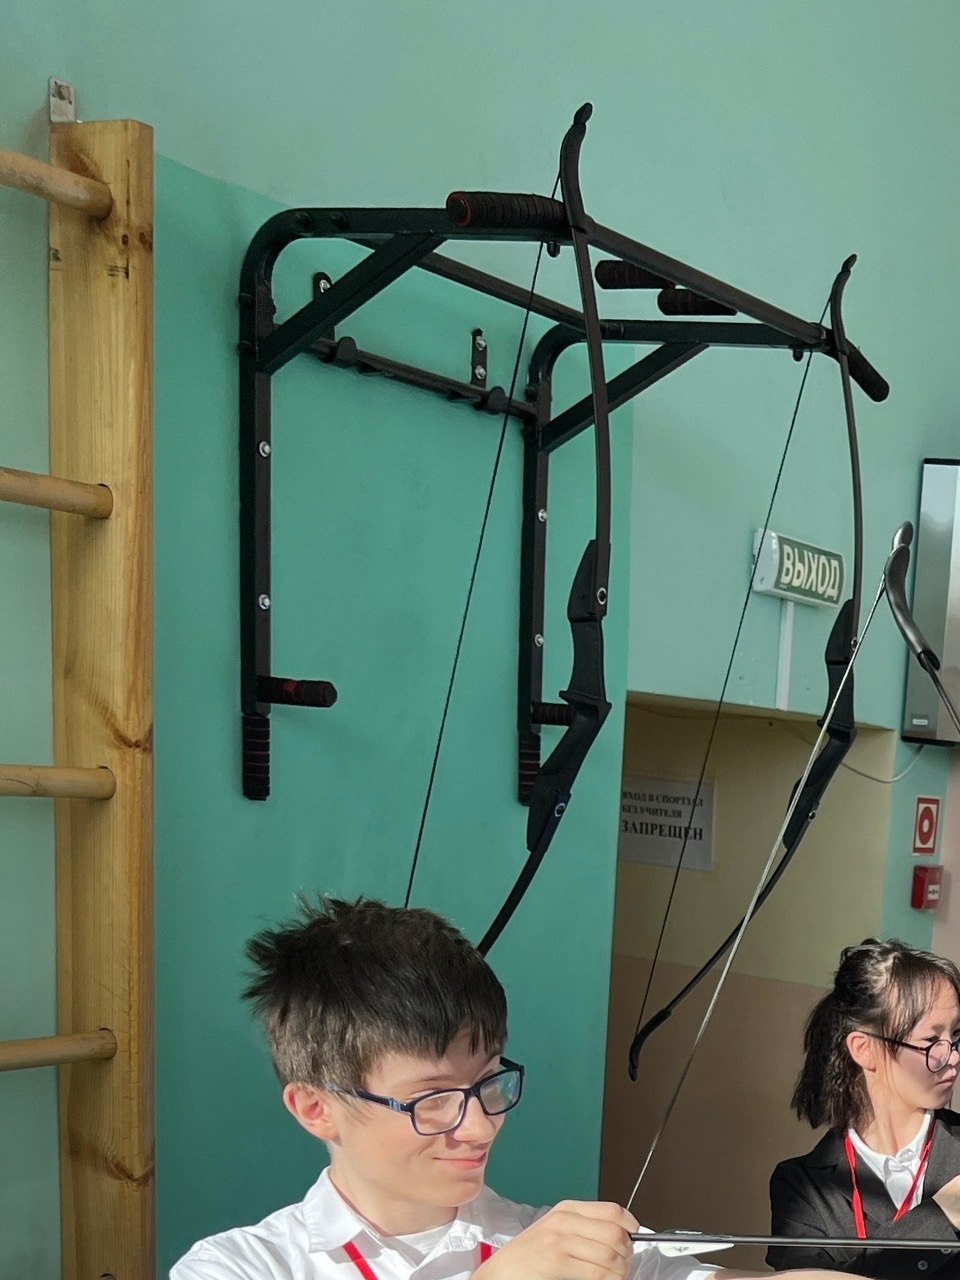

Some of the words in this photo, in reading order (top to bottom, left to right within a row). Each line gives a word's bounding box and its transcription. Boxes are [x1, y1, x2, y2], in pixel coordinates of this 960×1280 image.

[780, 545, 840, 600] ВЫХОД
[640, 806, 682, 819] УЧИТЕЛЯ
[622, 820, 703, 841] ЗАПРЕЩЕН
